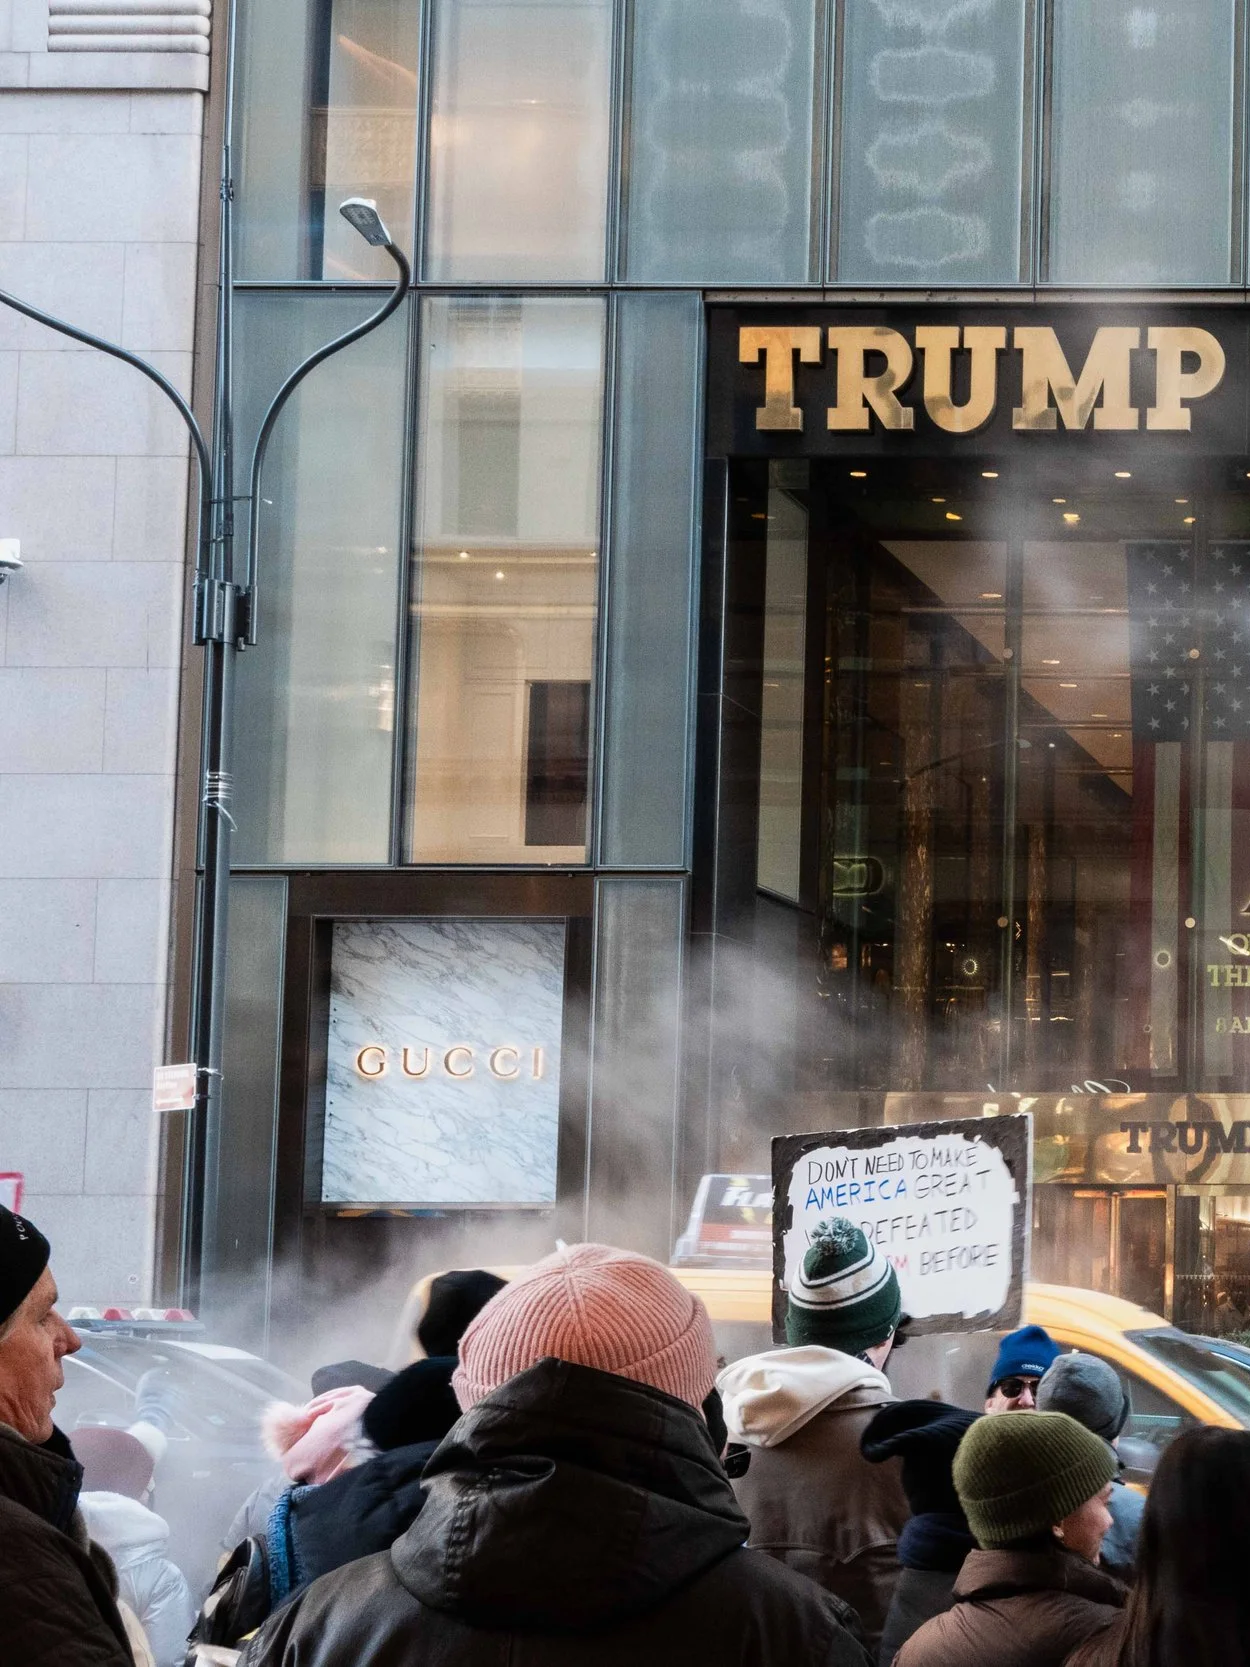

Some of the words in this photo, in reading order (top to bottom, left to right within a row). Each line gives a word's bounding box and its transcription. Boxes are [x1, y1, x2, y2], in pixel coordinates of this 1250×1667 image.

[738, 325, 1226, 435] TRUMP
[356, 1046, 544, 1080] GUCCI
[808, 1157, 858, 1185] DON'T
[865, 1152, 904, 1176] NEED
[908, 1150, 929, 1170] TO
[930, 1146, 978, 1168] MAKE
[805, 1178, 908, 1211] AMERICA
[914, 1169, 992, 1200] GREAT
[860, 1207, 978, 1245] DEFEATED
[920, 1243, 999, 1276] BEFORE
